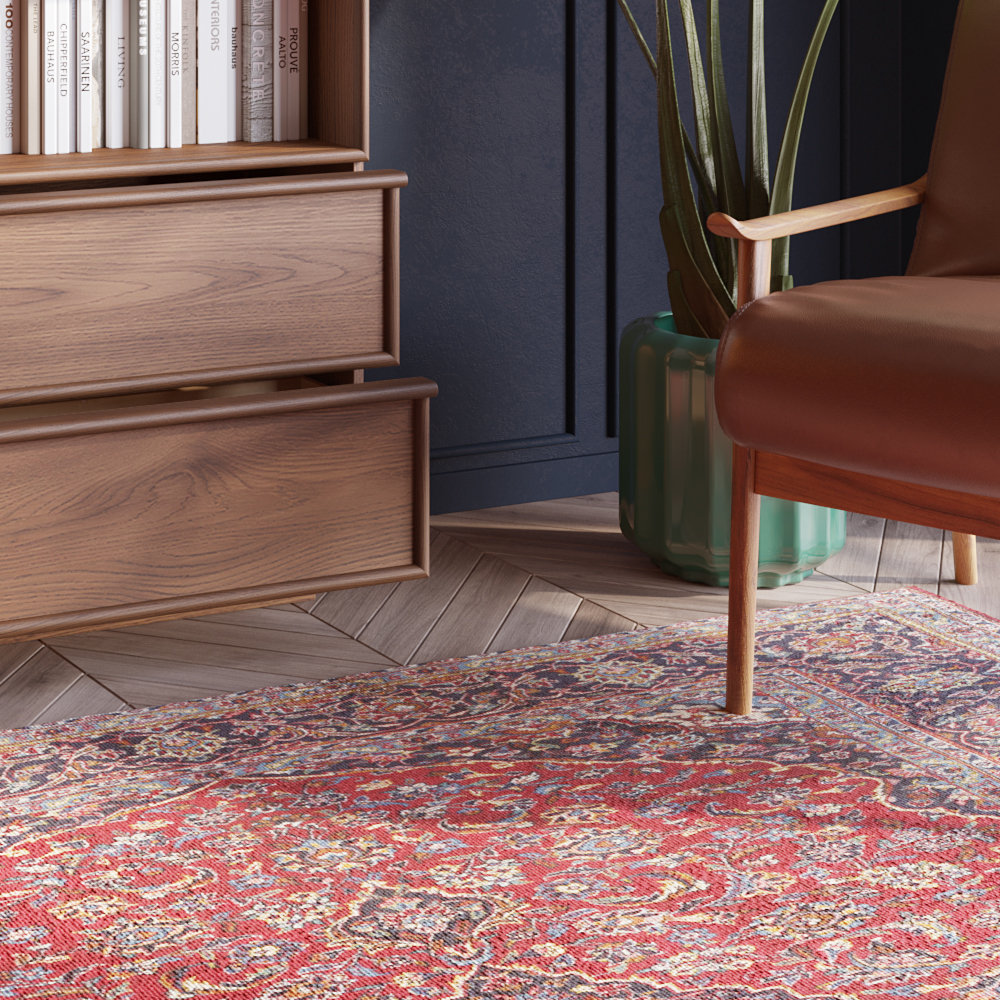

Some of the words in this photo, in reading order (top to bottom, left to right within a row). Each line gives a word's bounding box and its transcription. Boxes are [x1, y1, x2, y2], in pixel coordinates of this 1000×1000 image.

[5, 2, 14, 28] 100
[5, 29, 13, 100] CONTEMPORARY
[81, 32, 90, 92] SAARINEN
[5, 102, 13, 138] HOUSES
